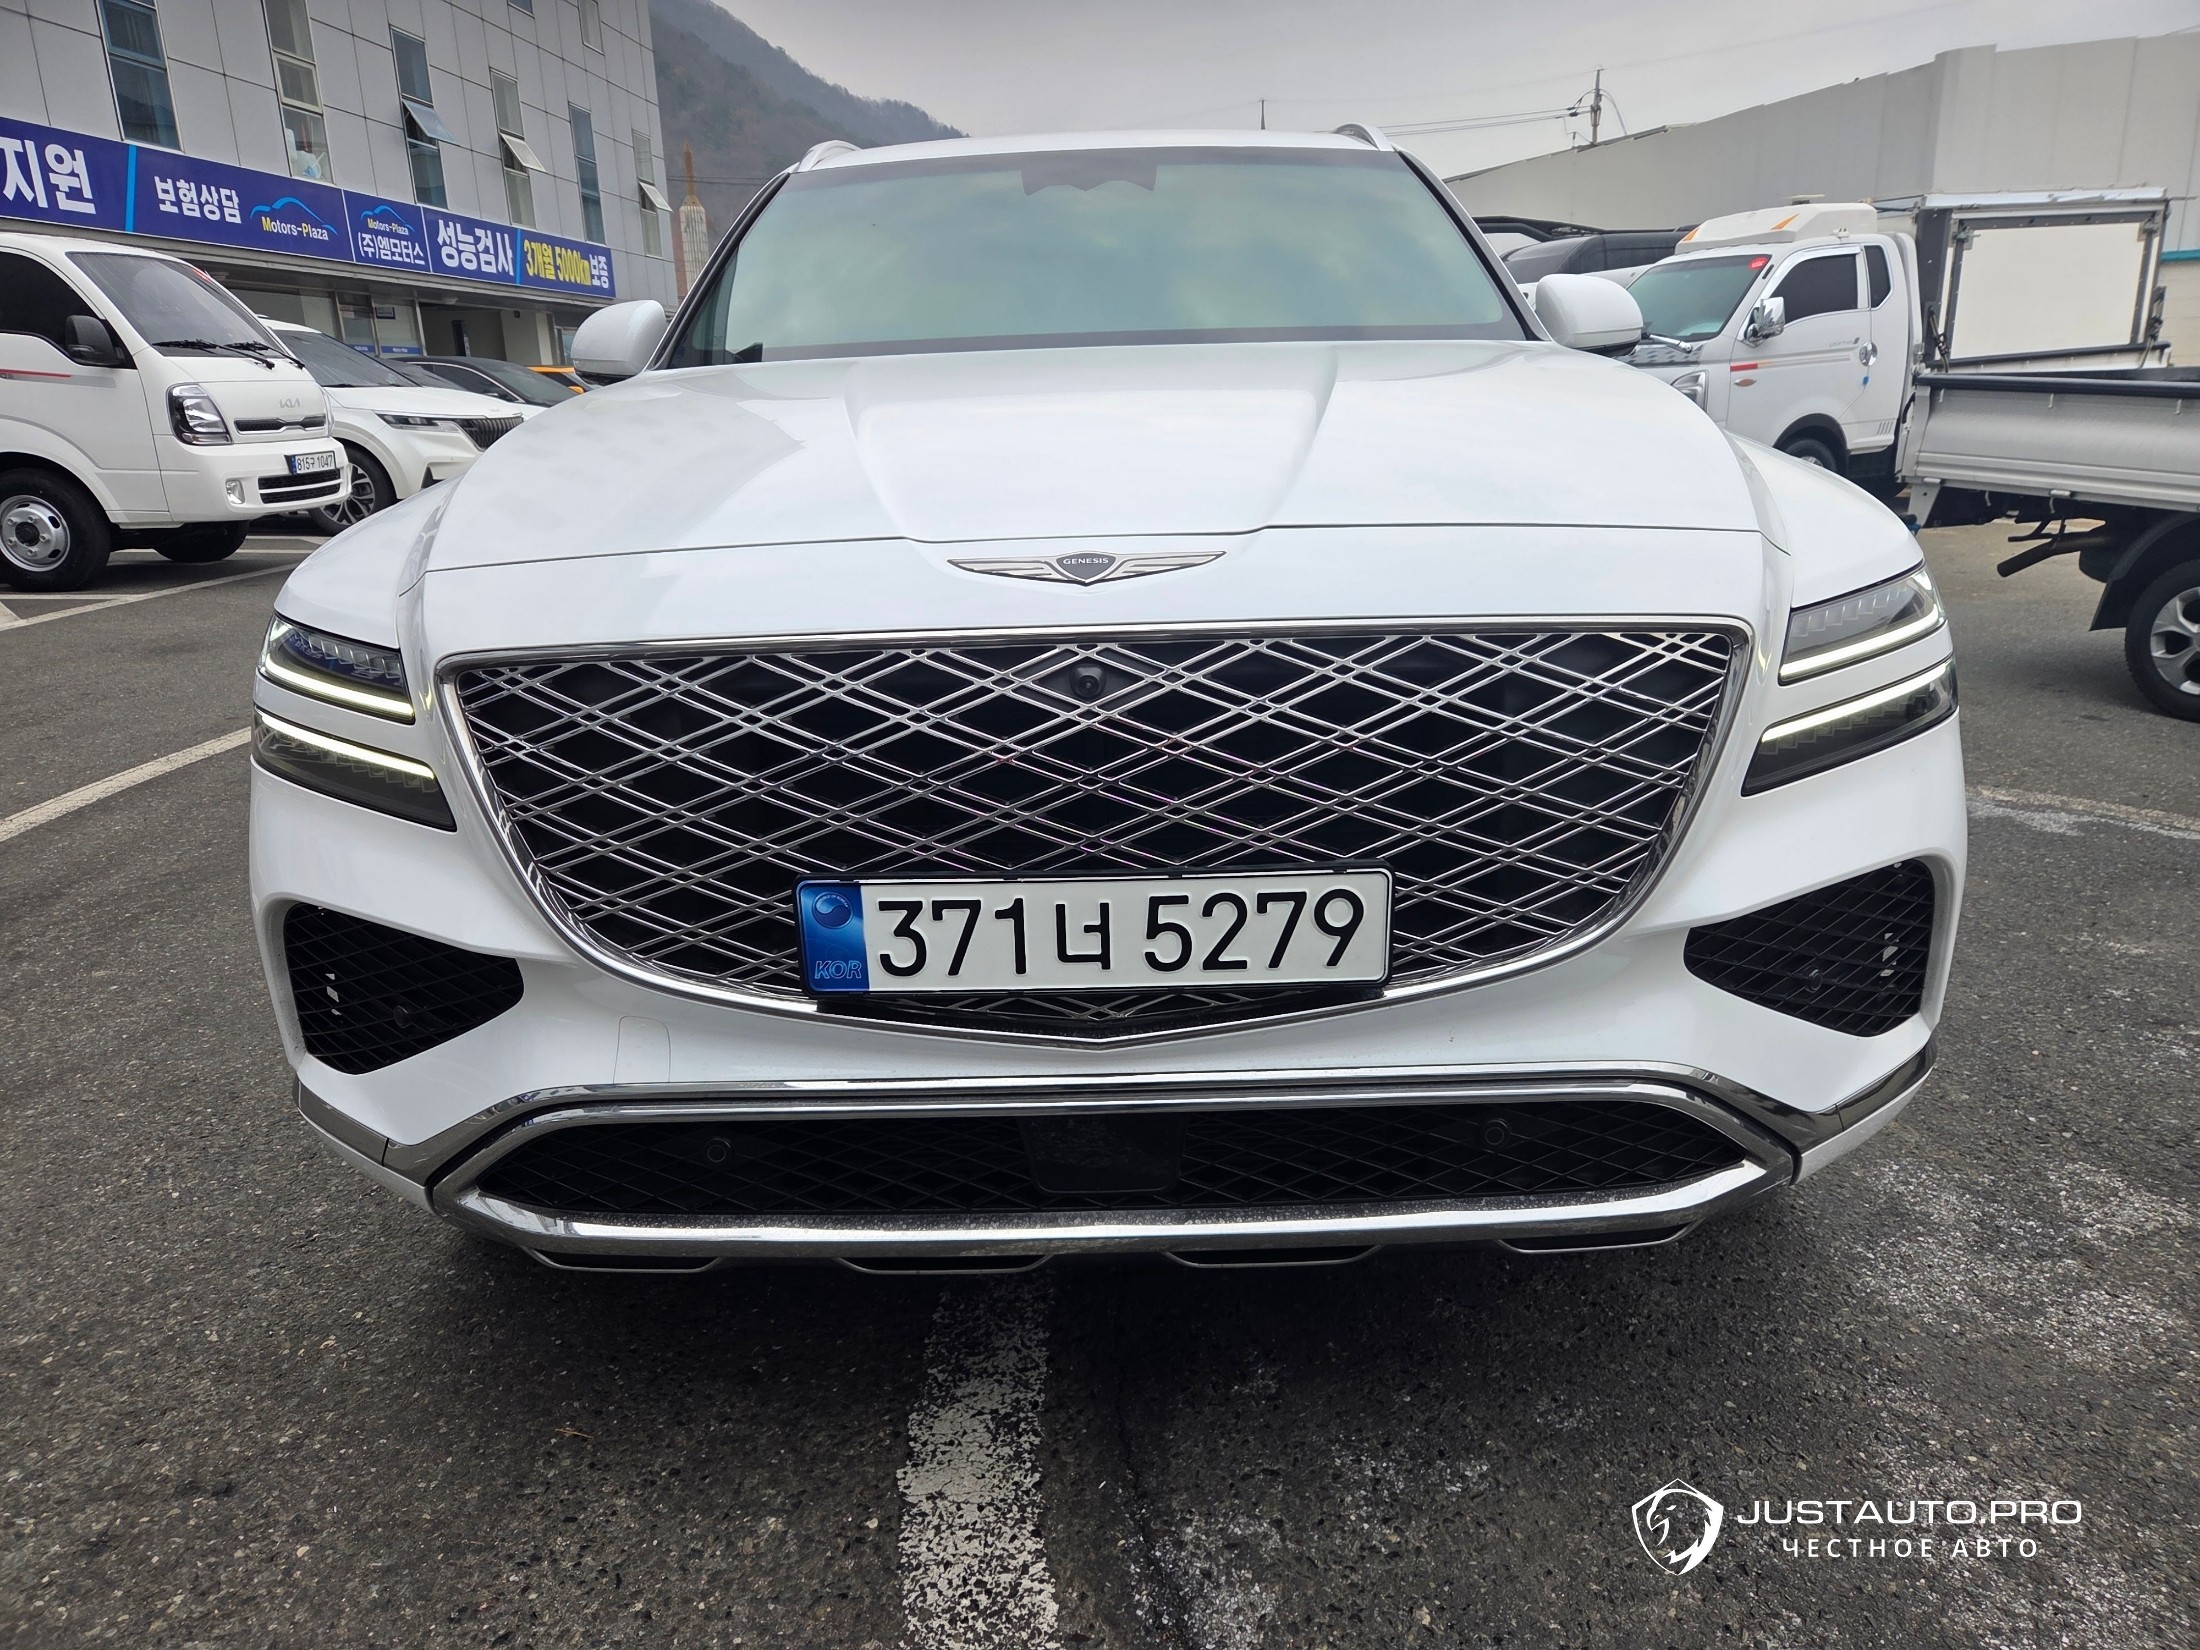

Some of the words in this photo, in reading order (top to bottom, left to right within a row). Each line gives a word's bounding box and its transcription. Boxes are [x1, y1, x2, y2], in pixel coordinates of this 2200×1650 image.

[0, 136, 96, 214] 지원
[153, 175, 242, 224] 보험상담
[261, 216, 329, 240] Motors-Plaza
[367, 218, 409, 235] Motors-Plaza
[358, 231, 426, 265] (주)엠모터스
[437, 219, 514, 277] 성능검사
[1062, 557, 1109, 565] GENESIS
[1143, 888, 1366, 973] 5279
[814, 960, 862, 979] KOR
